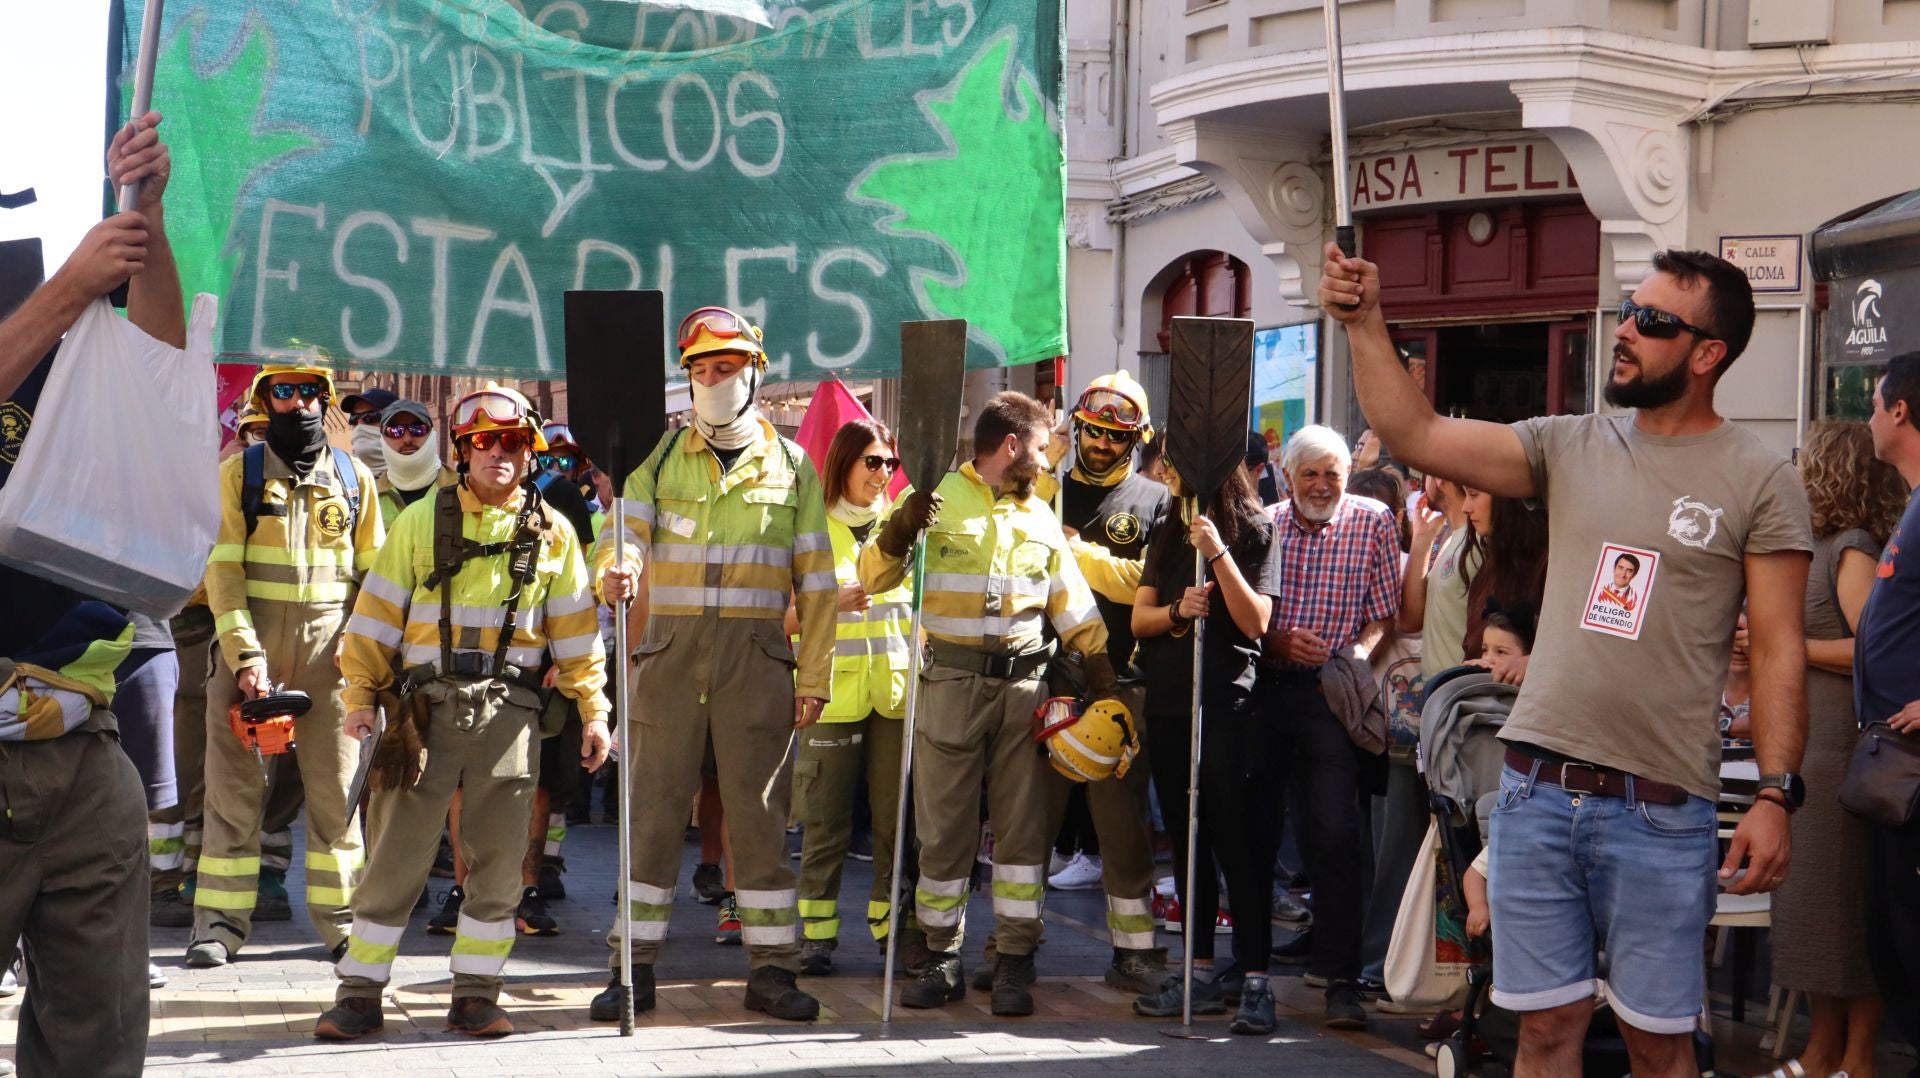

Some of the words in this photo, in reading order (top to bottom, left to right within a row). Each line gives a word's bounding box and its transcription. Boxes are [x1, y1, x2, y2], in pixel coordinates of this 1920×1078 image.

[1350, 154, 1422, 206] ASA
[533, 164, 595, 238] Y
[1745, 246, 1777, 258] CALLE
[1742, 265, 1785, 281] ALOMA
[1845, 326, 1887, 345] ÁGUILA
[1592, 604, 1632, 619] PELIGRO
[1588, 612, 1598, 621] DE
[1599, 615, 1633, 629] INCENDIO
